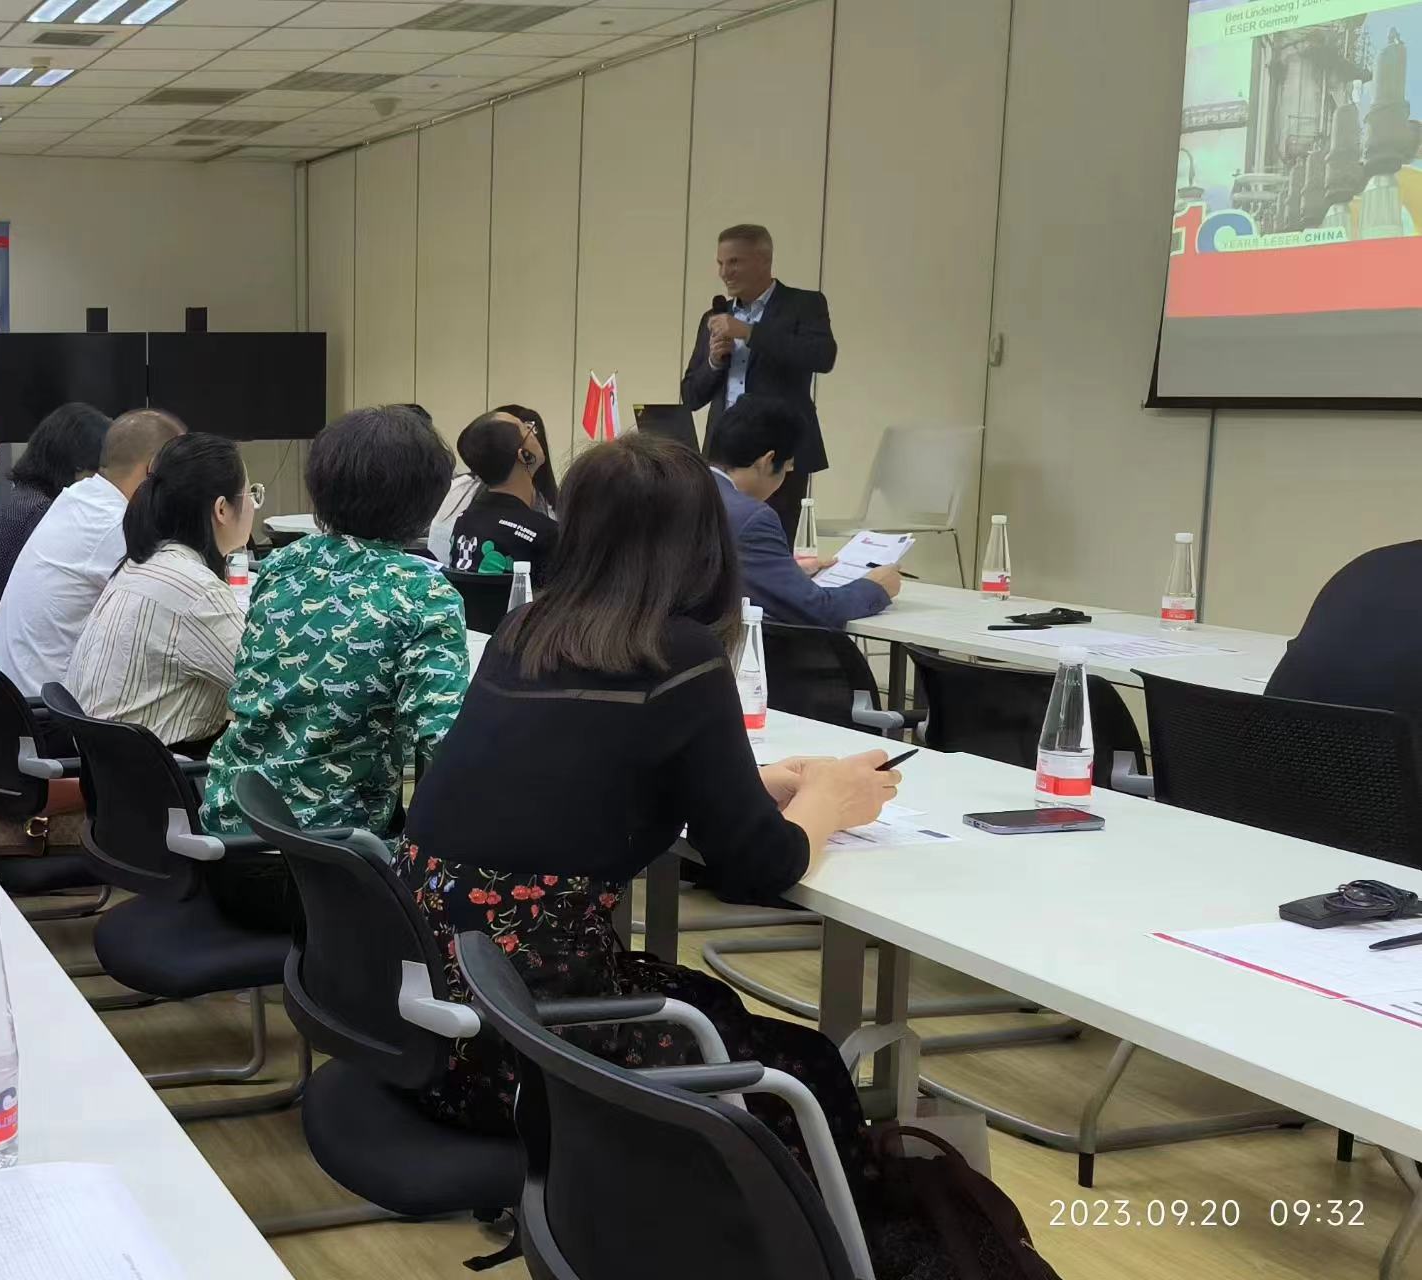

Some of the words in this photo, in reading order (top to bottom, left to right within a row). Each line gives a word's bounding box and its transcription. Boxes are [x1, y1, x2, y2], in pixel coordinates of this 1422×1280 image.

[1224, 21, 1257, 36] LESER
[1258, 14, 1299, 30] Germany
[1304, 230, 1344, 242] CHINA
